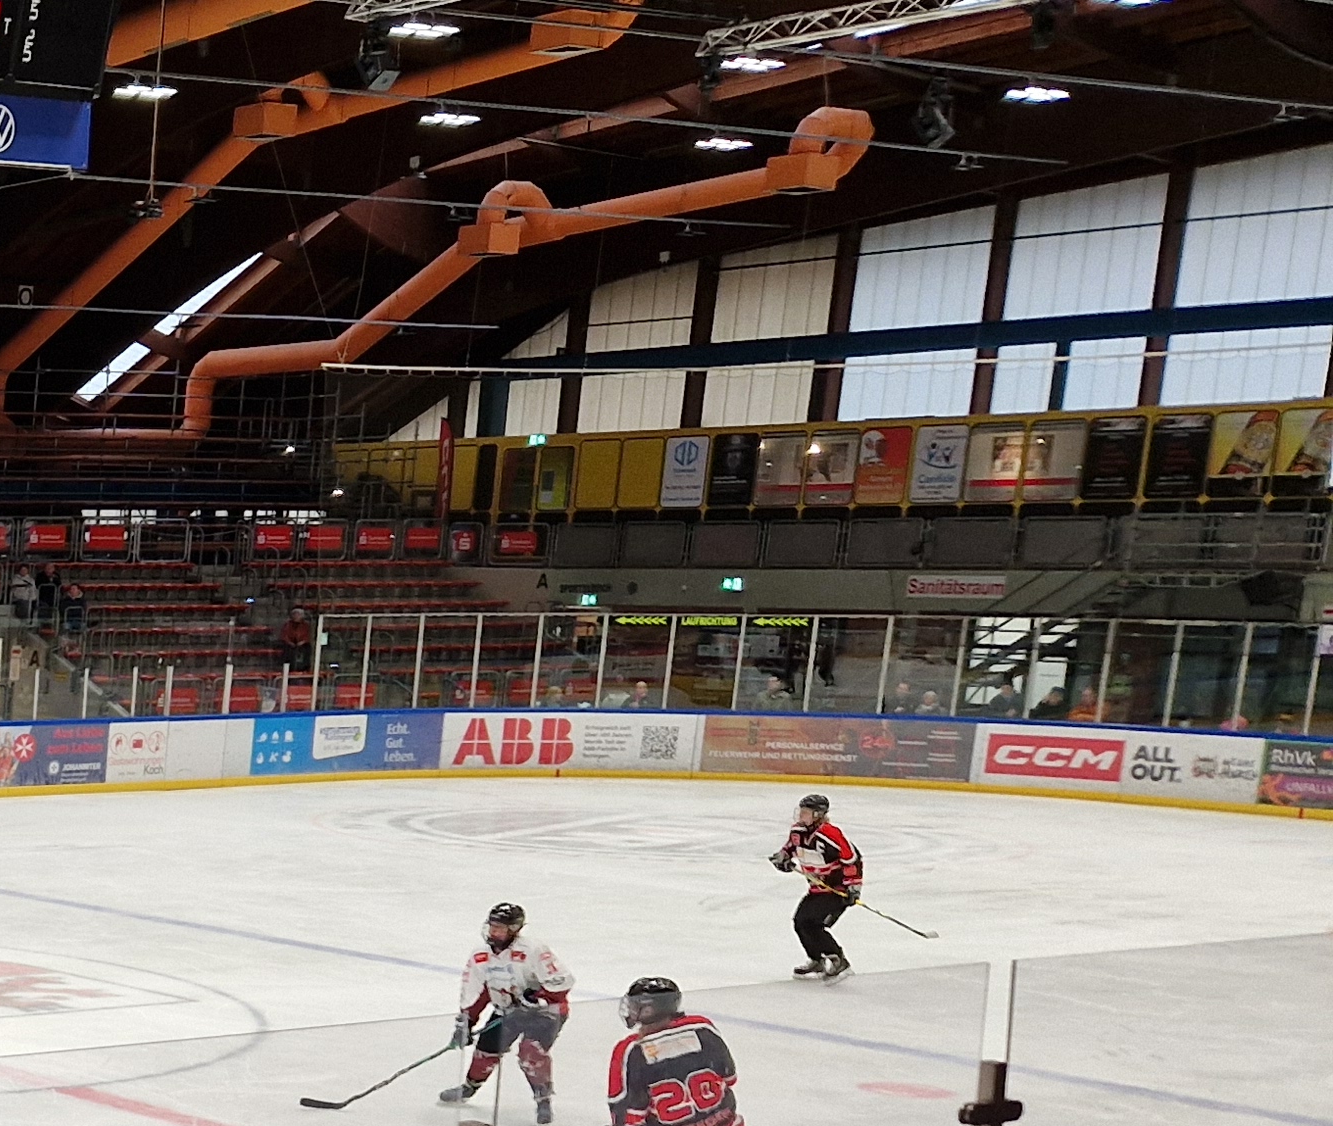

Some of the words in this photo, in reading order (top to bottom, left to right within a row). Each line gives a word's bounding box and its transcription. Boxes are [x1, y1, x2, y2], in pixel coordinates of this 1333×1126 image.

[536, 573, 548, 589] A
[907, 577, 1005, 597] Sanitätsraum
[386, 722, 410, 735] Echt.
[385, 737, 405, 749] Gut.
[452, 717, 574, 765] ABB
[384, 751, 416, 762] Leben.
[993, 744, 1119, 771] CCM
[1134, 745, 1174, 764] ALL
[1131, 762, 1182, 783] OUT.
[648, 1068, 726, 1124] 20
